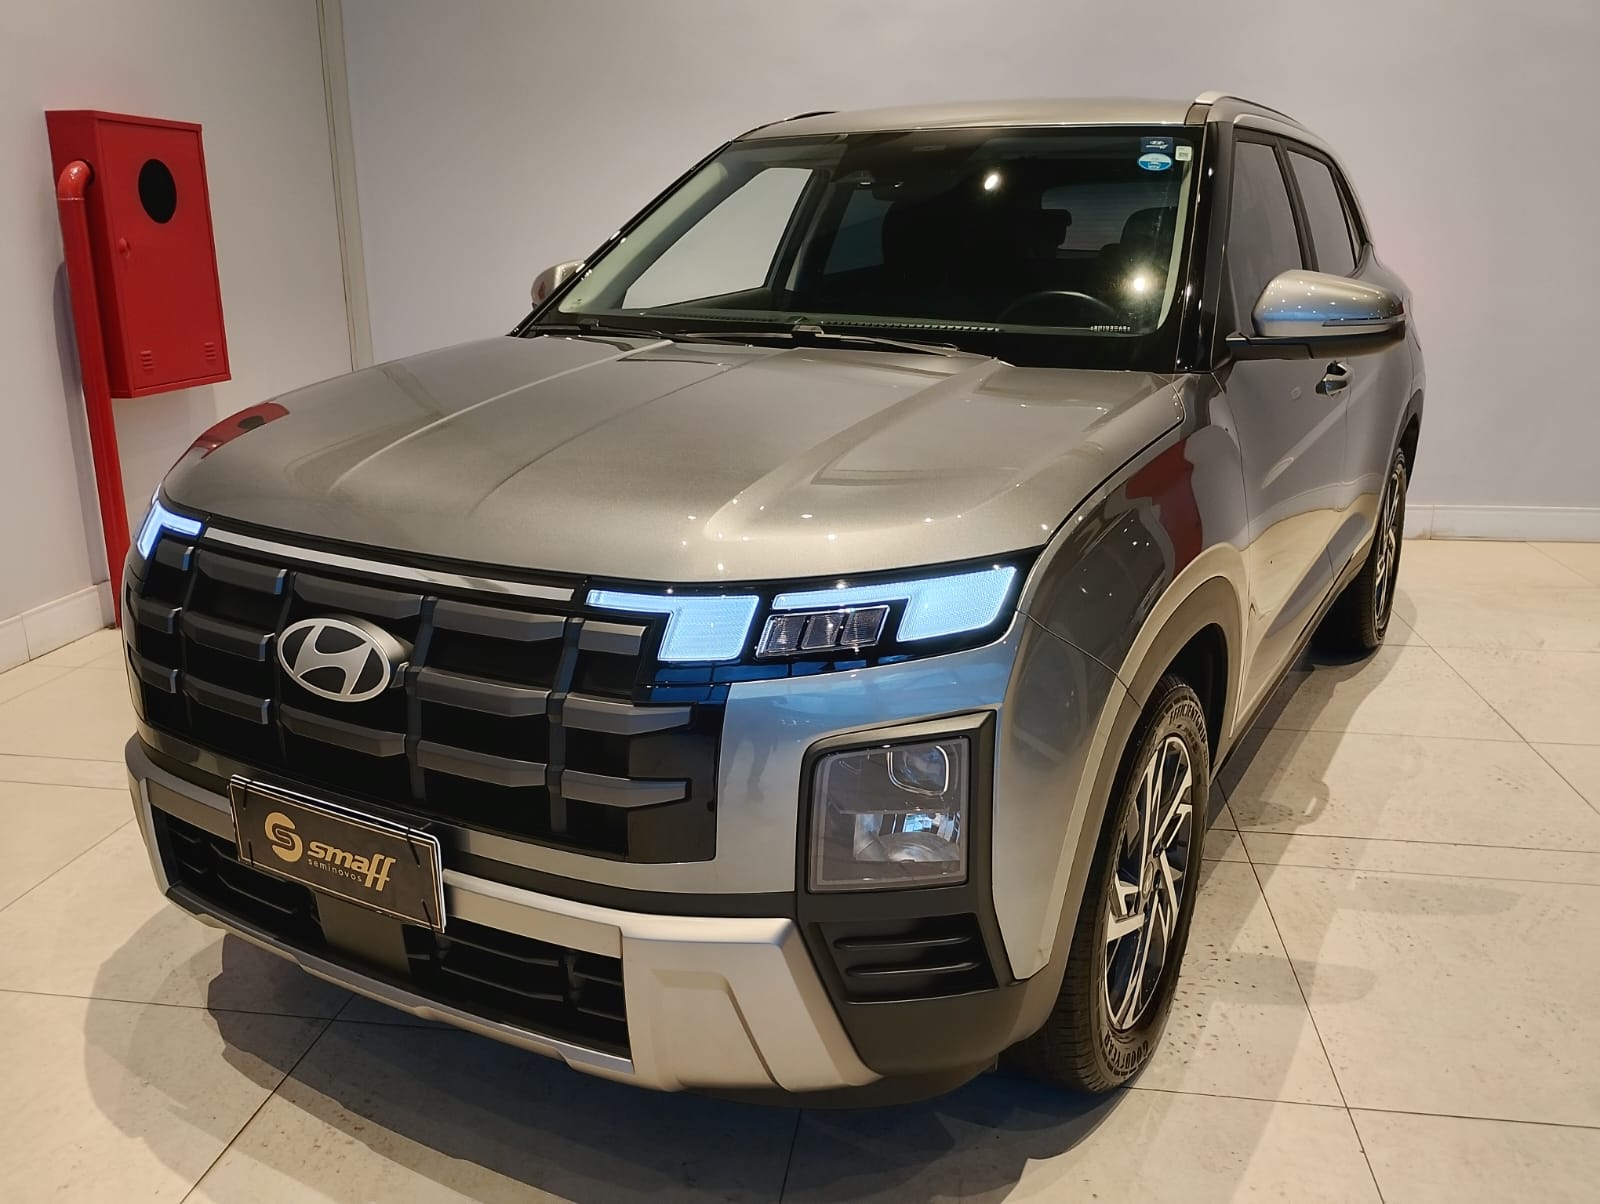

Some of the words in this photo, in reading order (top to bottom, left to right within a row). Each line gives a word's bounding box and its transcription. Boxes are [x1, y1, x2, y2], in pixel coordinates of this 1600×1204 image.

[307, 841, 396, 891] smaff
[308, 858, 362, 882] seminovos
[1104, 1030, 1149, 1069] GOODYEAR
